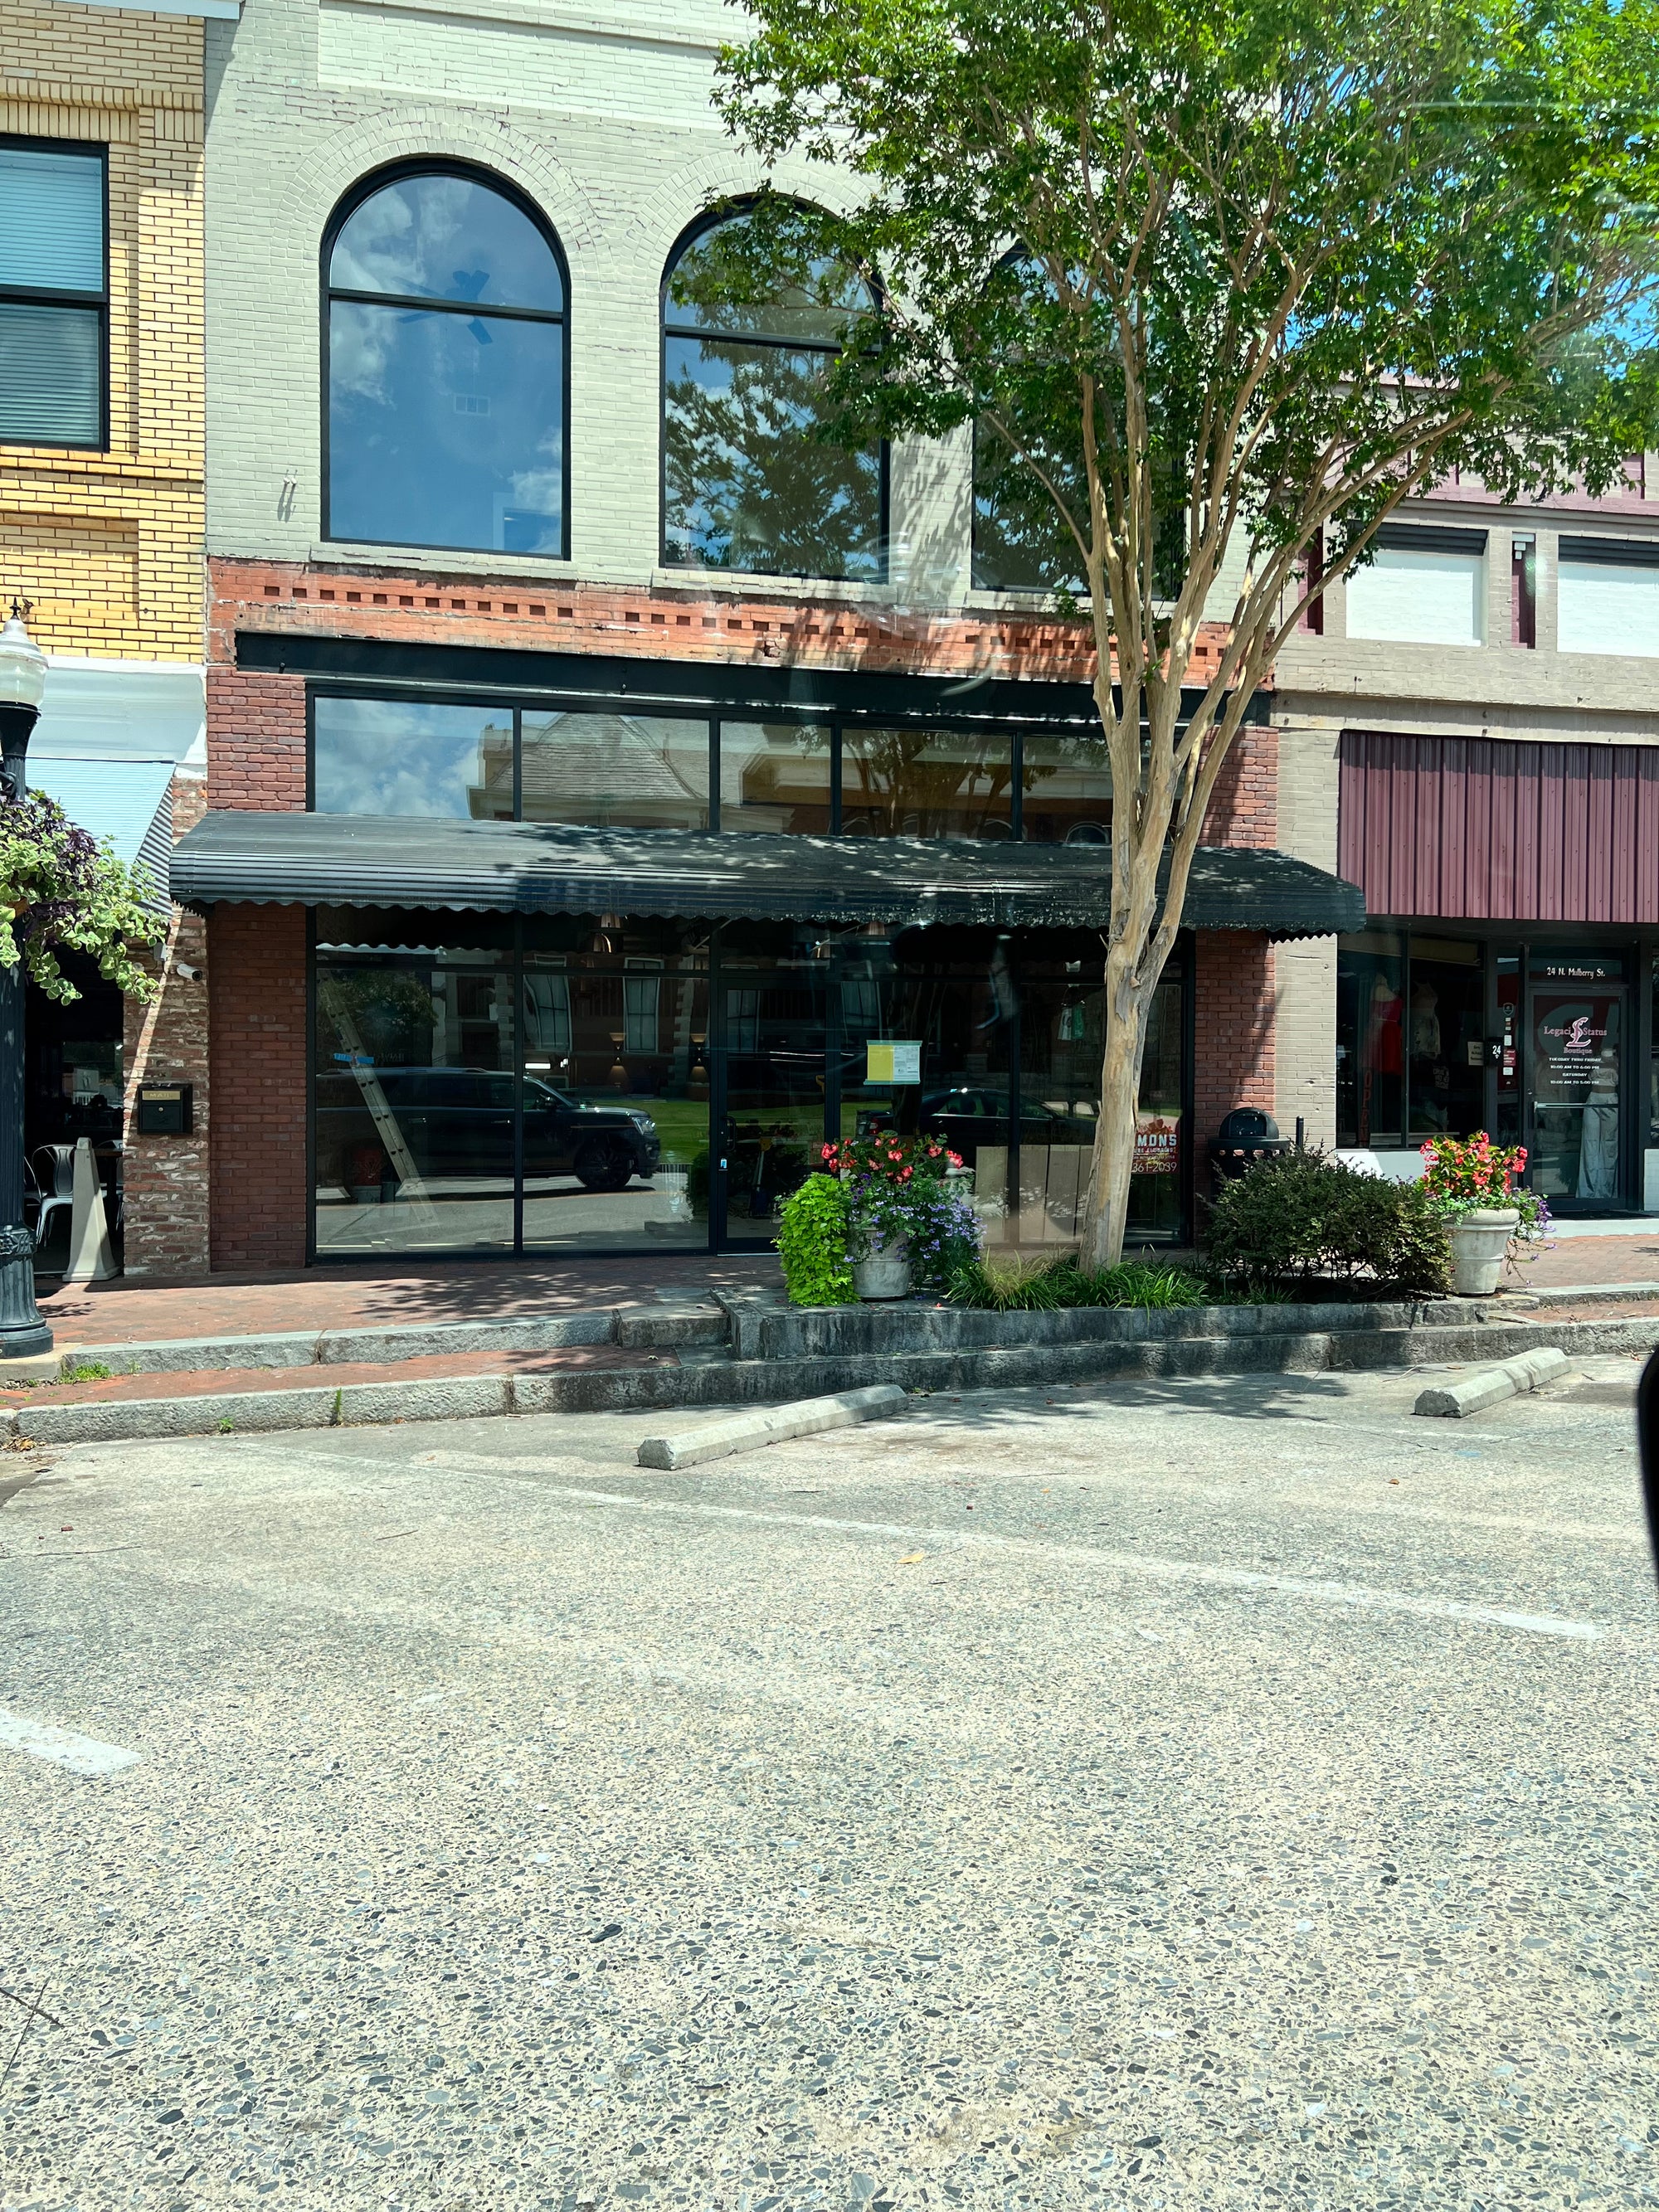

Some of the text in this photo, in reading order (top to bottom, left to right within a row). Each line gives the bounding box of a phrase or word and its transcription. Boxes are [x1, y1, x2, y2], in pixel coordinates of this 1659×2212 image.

[1546, 966, 1556, 976] 24
[1568, 968, 1594, 980] Mulberry
[1596, 968, 1606, 977] St.
[1544, 1026, 1608, 1037] Legaci Status
[1492, 1045, 1501, 1054] 24
[1564, 1047, 1593, 1055] Boutique
